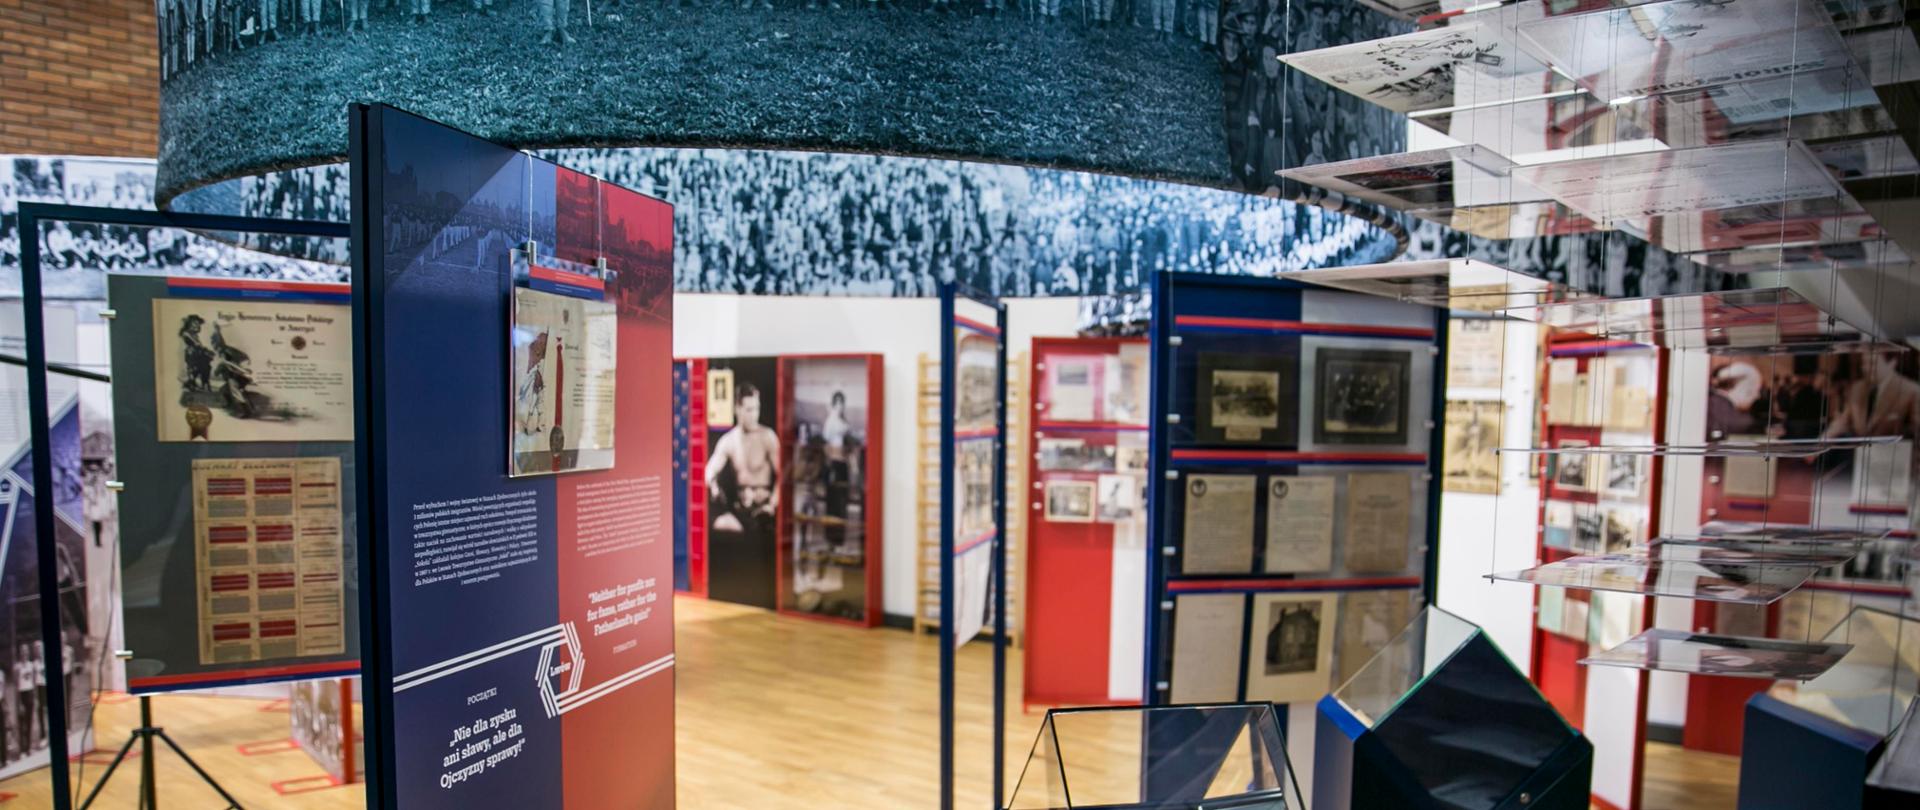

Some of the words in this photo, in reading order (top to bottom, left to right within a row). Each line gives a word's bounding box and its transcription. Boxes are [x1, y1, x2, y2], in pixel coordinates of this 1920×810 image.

[617, 584, 626, 596] for
[627, 579, 644, 595] profit
[587, 609, 597, 622] for
[617, 598, 636, 612] rather
[637, 595, 646, 606] for
[646, 592, 656, 602] the
[550, 662, 571, 677] Lwów
[467, 687, 497, 705] POCZĄTKI
[450, 728, 471, 747] „Nie
[473, 718, 488, 735] dla
[490, 707, 517, 728] zysku
[443, 749, 460, 767] ani
[462, 738, 491, 759] sławy,
[493, 729, 506, 745] ale
[508, 723, 523, 738] dla
[440, 760, 485, 789] Ojczyzny
